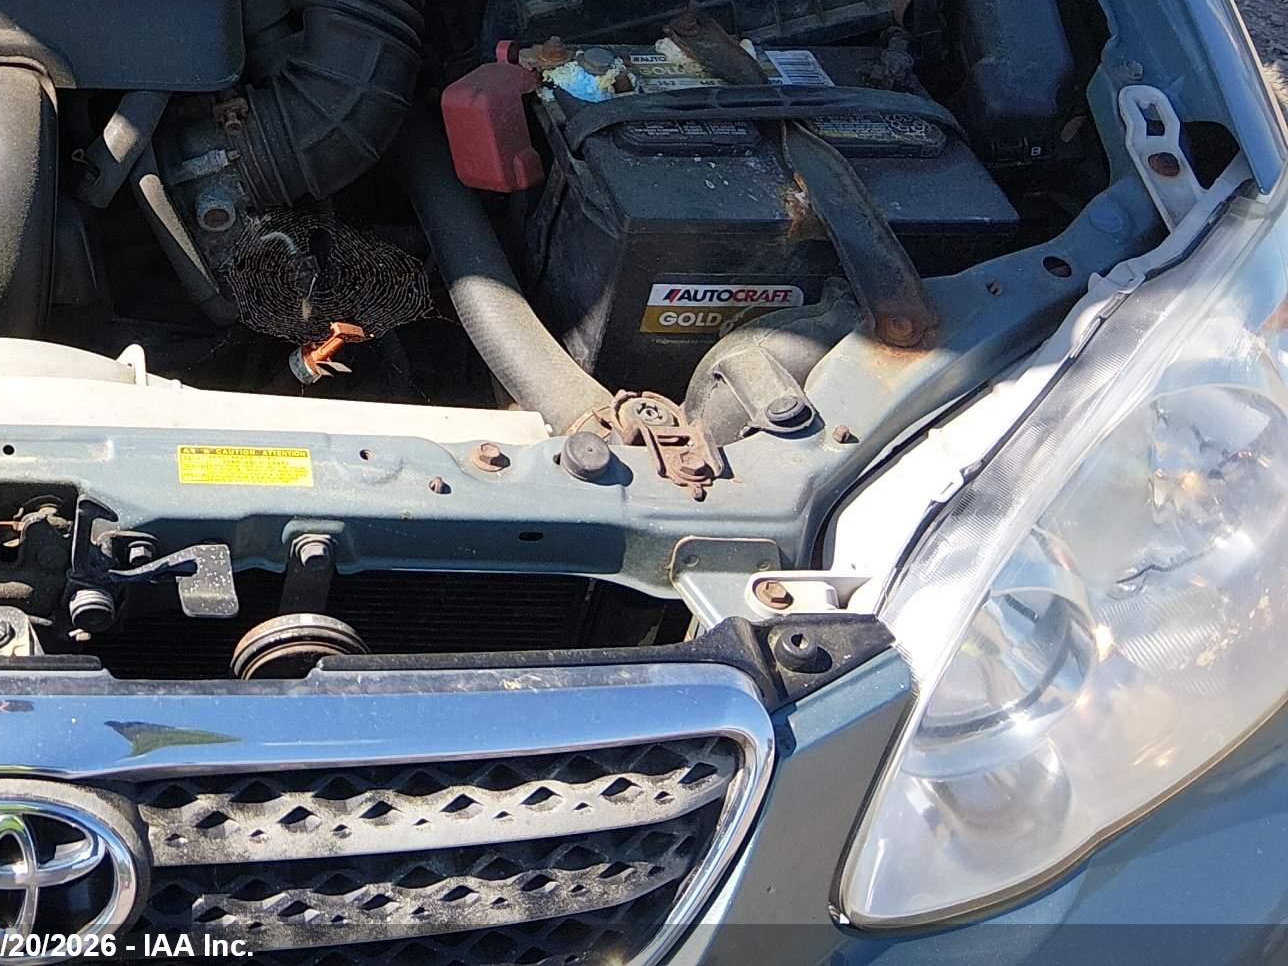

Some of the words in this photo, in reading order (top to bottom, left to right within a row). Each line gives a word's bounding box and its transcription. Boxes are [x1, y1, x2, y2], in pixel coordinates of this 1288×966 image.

[677, 289, 793, 303] AUTOCRAFT
[658, 311, 722, 327] GOLD
[216, 448, 256, 456] CAUTION
